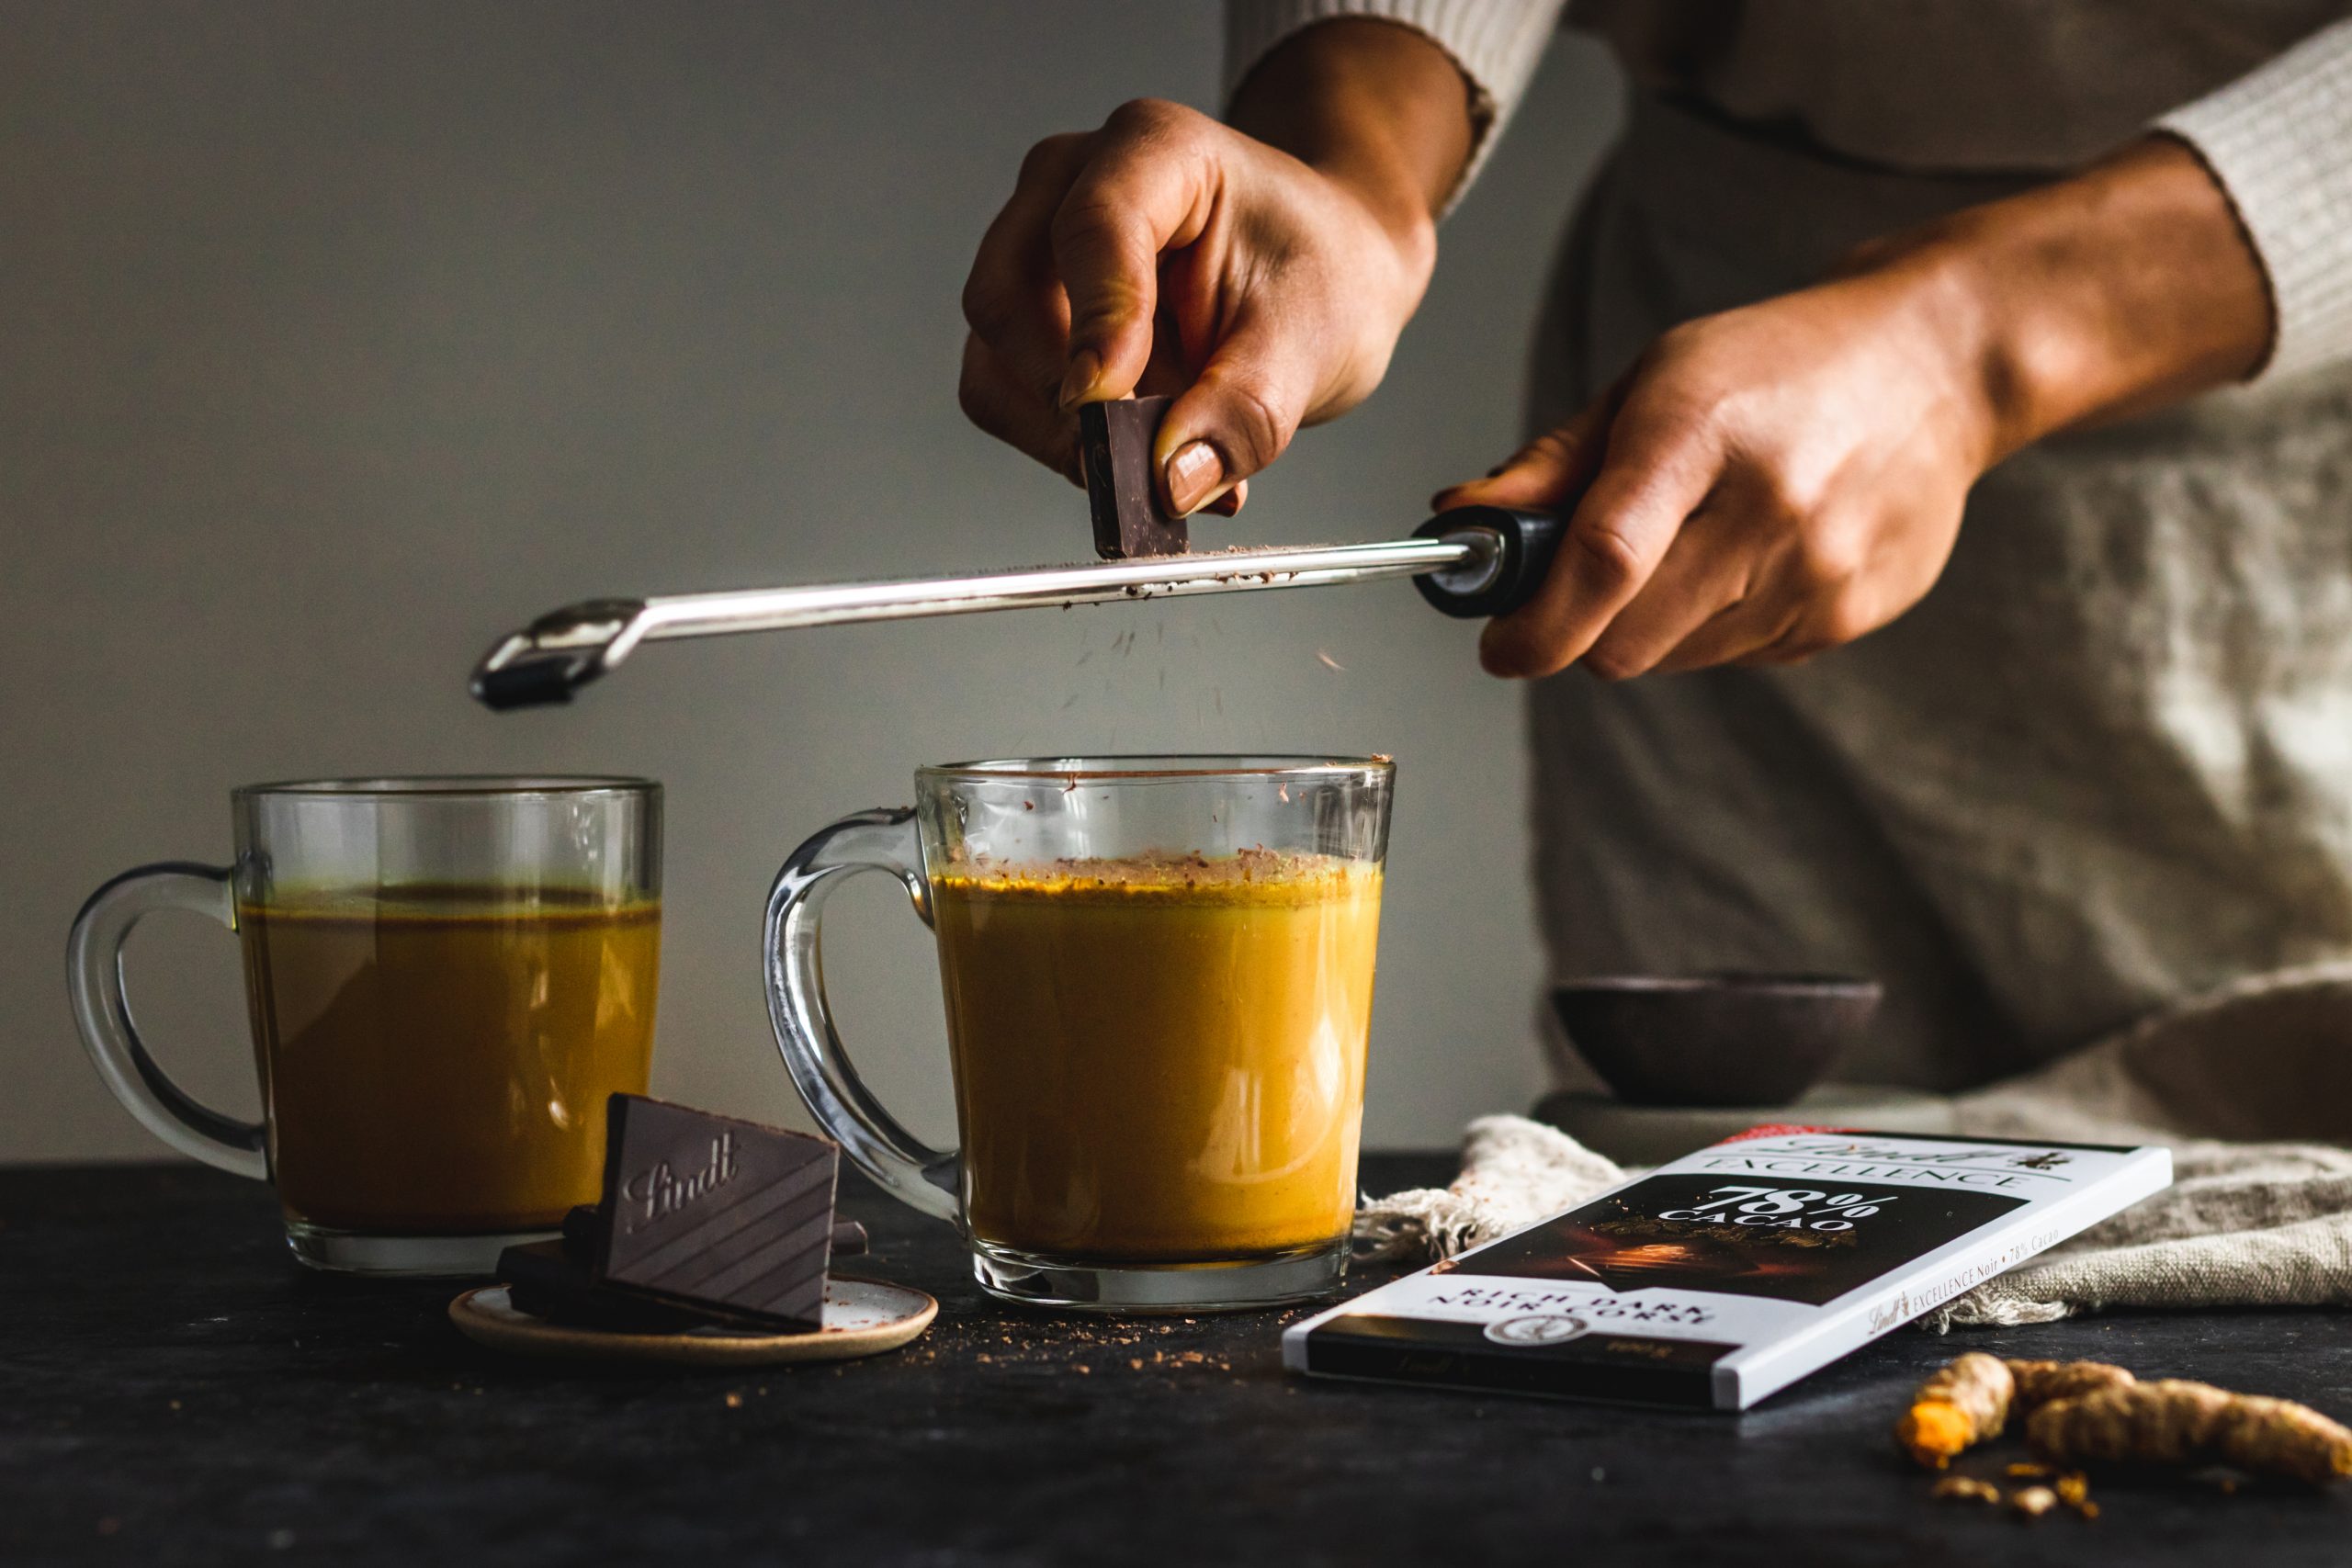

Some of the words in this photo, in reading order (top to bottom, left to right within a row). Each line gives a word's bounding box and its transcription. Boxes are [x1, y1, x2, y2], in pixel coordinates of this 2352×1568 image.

[622, 1130, 742, 1235] Lindt
[1704, 1158, 2030, 1189] EXCELLENCE
[1693, 1185, 1899, 1218] 78%
[1658, 1209, 1854, 1232] CACAO
[1913, 1269, 1974, 1313] EXCELLENCE
[1976, 1260, 1998, 1279] Noir
[2031, 1229, 2059, 1250] Cacao
[1427, 1294, 1544, 1313] NOIR
[1460, 1287, 1571, 1303] RICH
[1590, 1297, 1714, 1315] DARK
